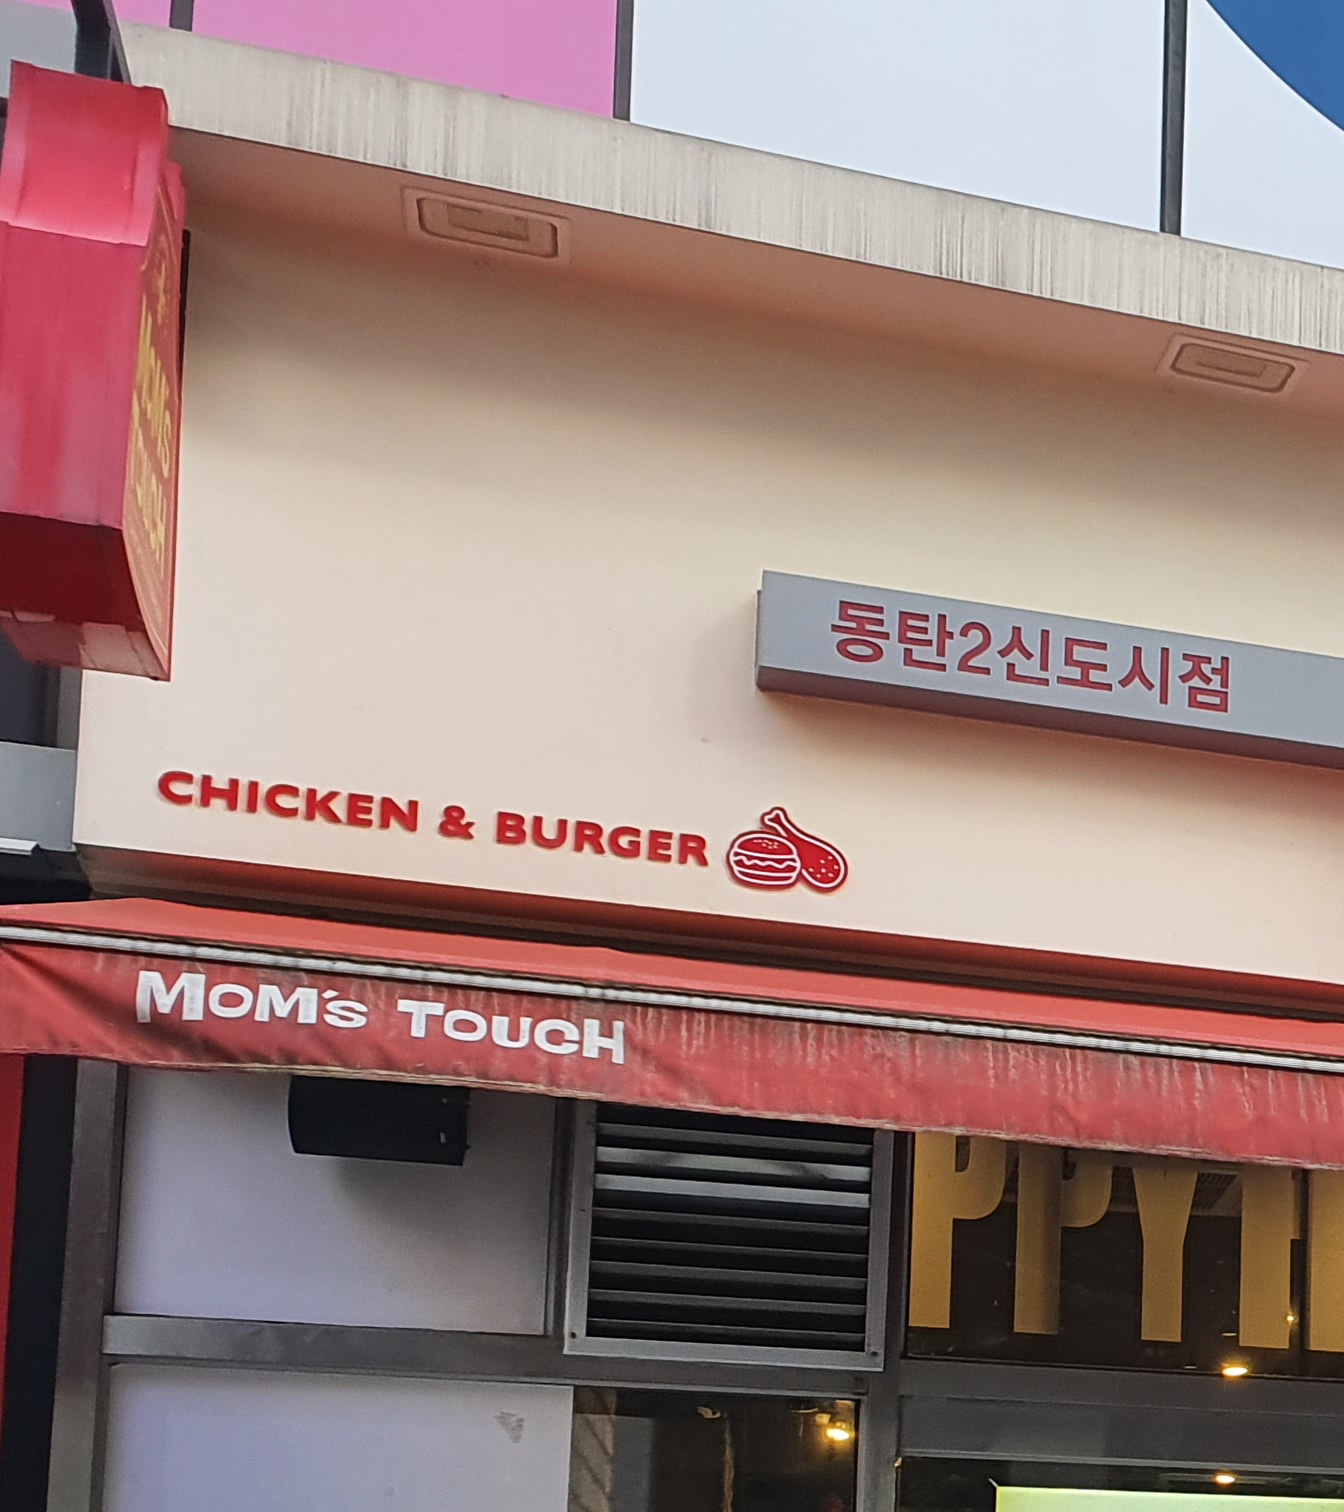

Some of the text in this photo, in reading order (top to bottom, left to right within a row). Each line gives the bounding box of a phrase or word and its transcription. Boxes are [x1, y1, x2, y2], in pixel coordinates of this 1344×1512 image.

[830, 599, 1231, 714] 동탄2신도시점
[157, 769, 710, 868] CHICKEN & BURGER
[397, 999, 626, 1065] TOUCH
